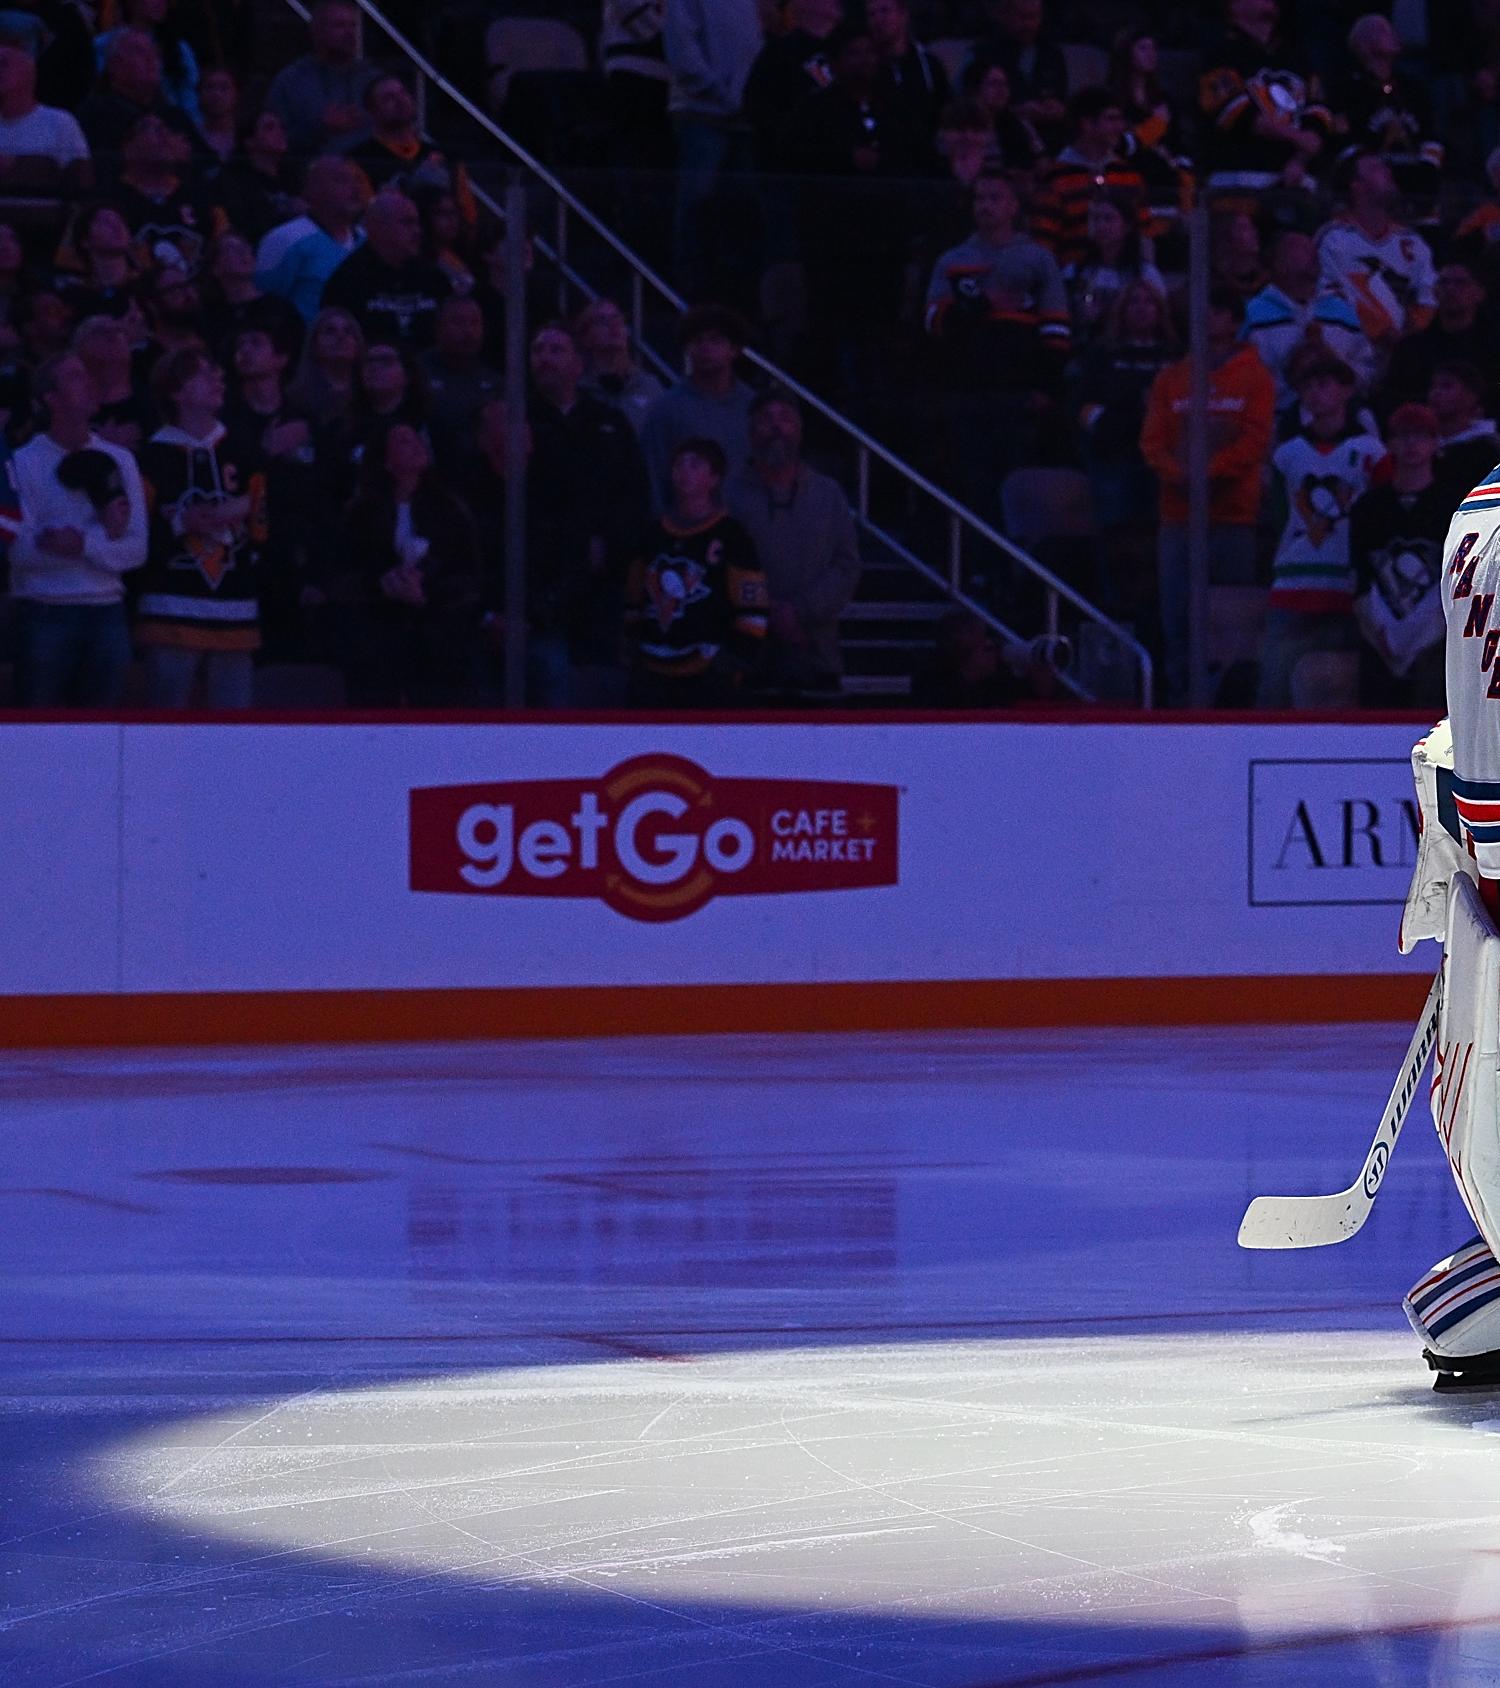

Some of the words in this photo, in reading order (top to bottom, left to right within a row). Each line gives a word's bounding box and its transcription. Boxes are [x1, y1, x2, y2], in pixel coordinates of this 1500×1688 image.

[771, 810, 848, 836] CAFE
[456, 790, 755, 887] getGo
[772, 838, 876, 862] MARKET
